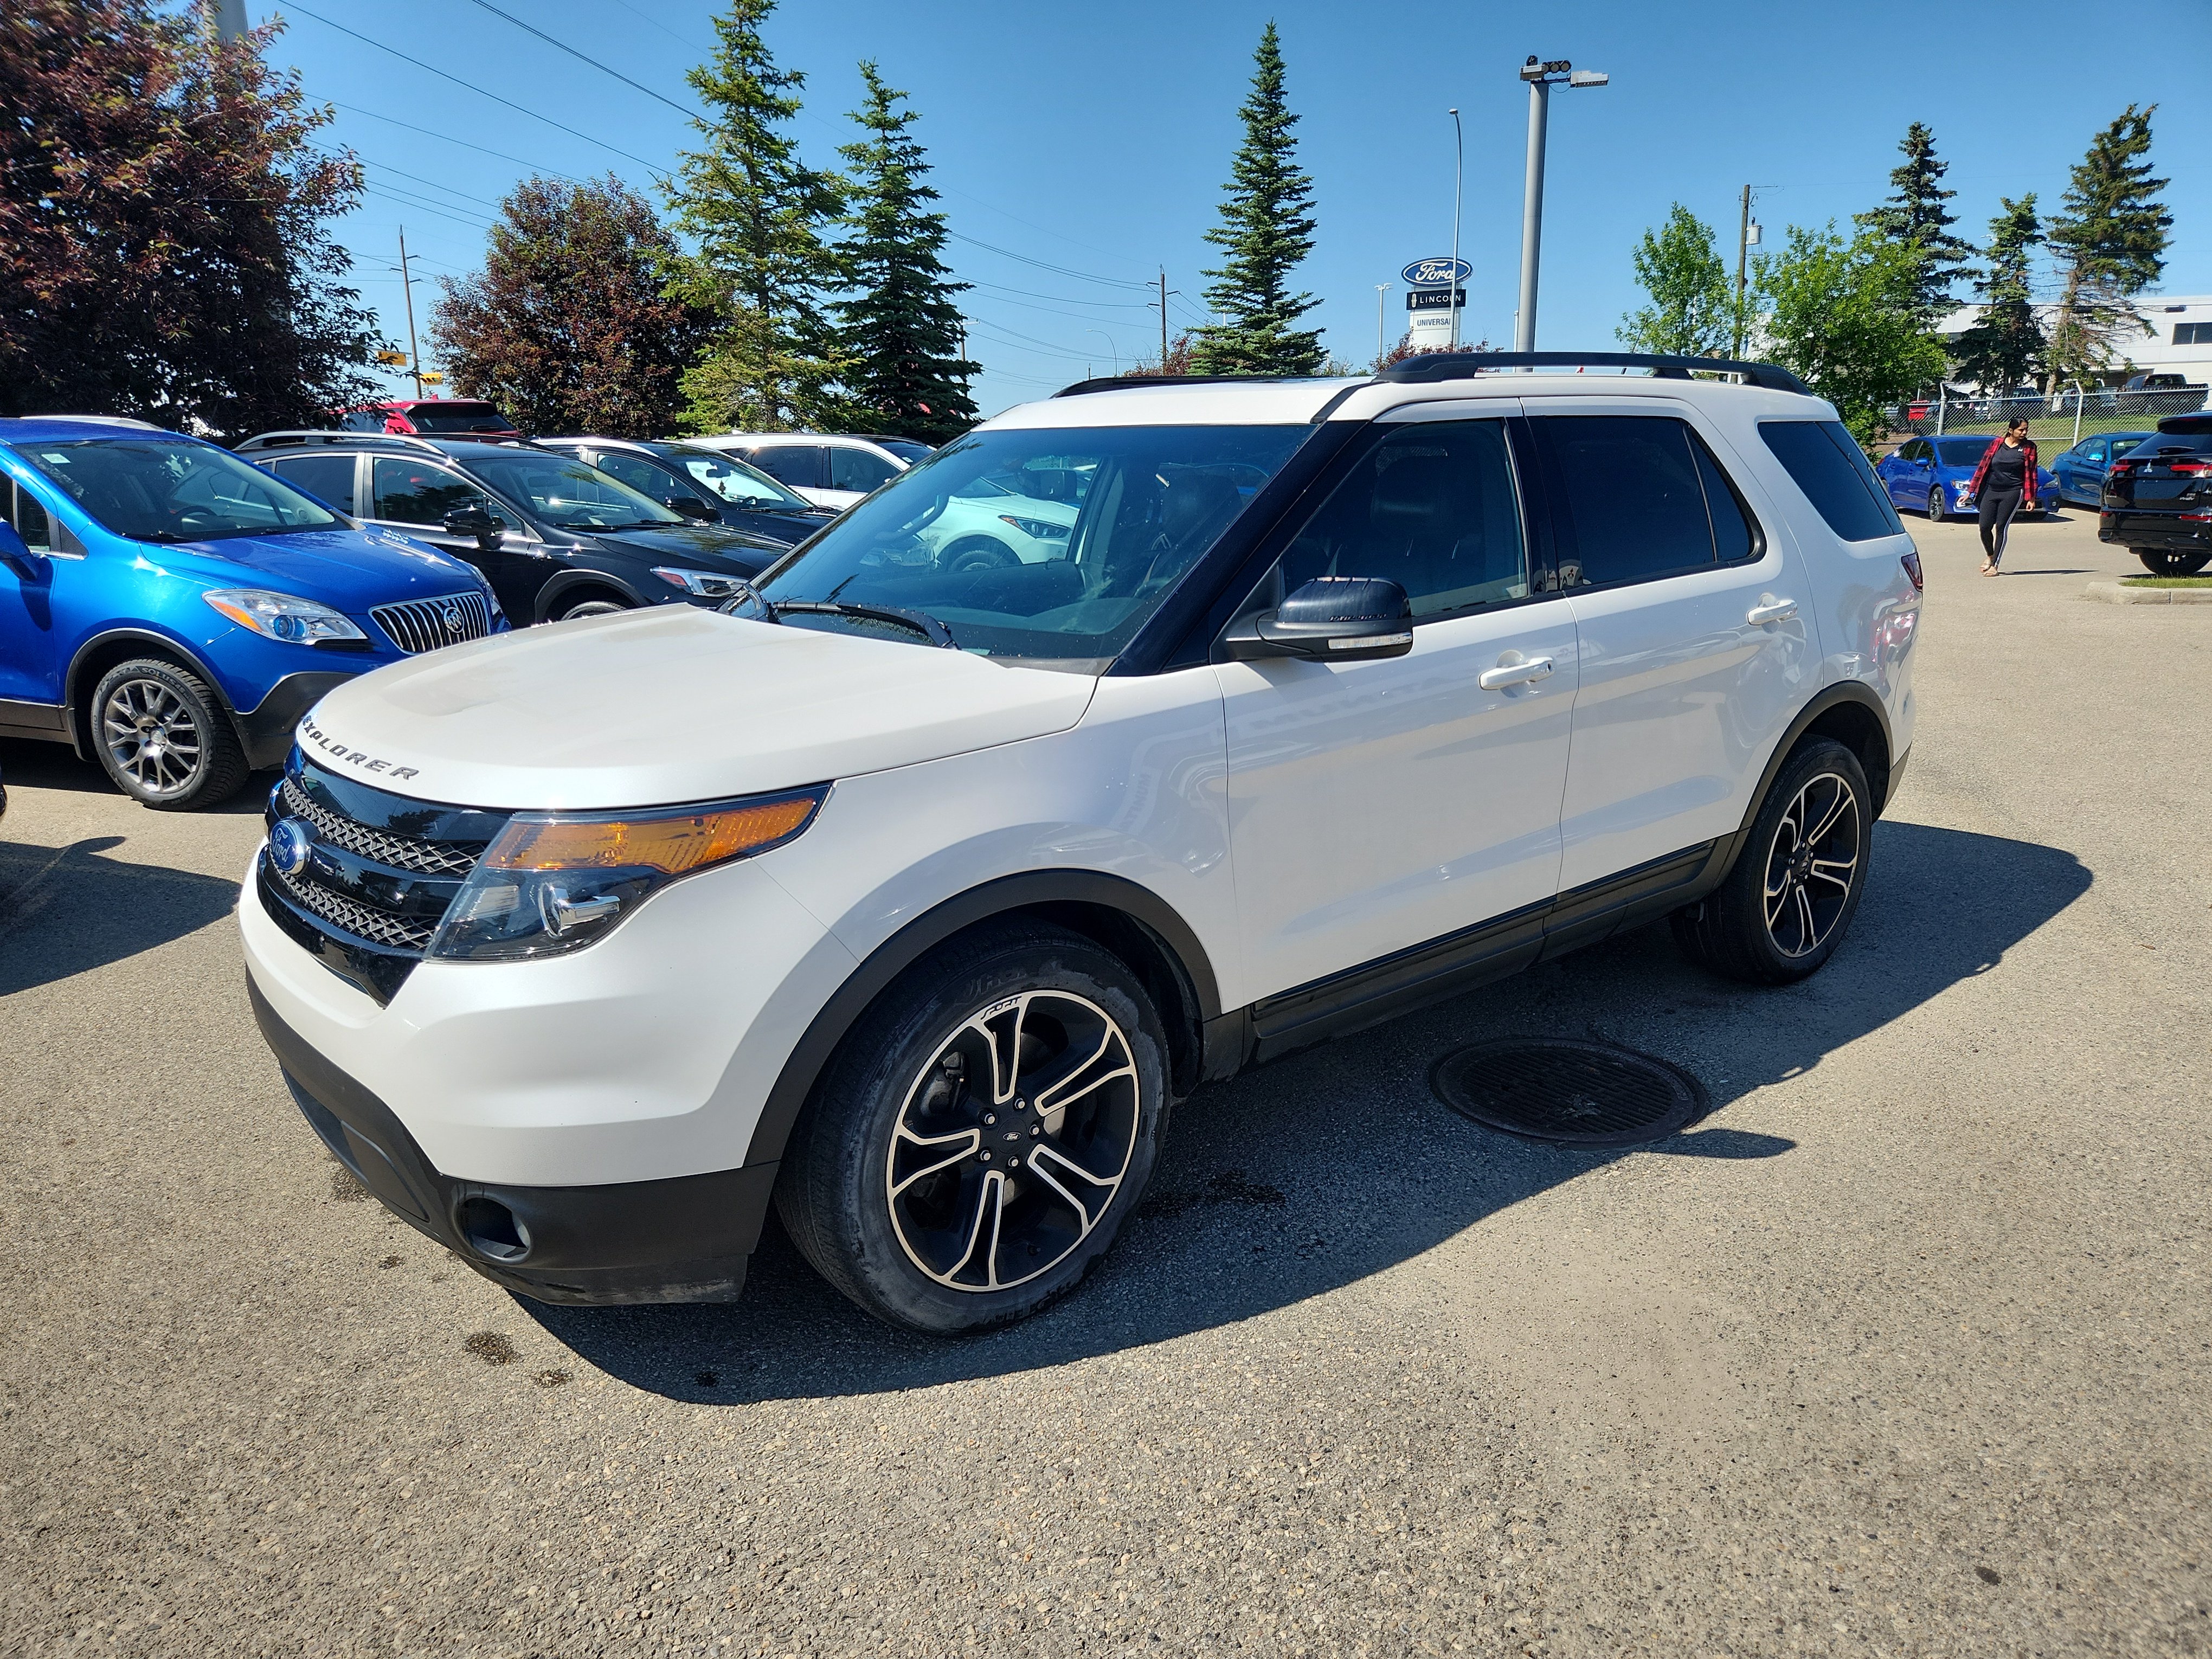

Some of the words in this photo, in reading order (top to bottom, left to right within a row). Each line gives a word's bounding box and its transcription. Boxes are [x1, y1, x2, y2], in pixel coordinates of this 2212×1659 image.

[1416, 262, 1455, 281] Ford
[142, 667, 177, 685] SOLUS
[303, 715, 420, 781] EXPLORER
[271, 827, 290, 863] Ford
[980, 996, 1022, 1020] SPORT
